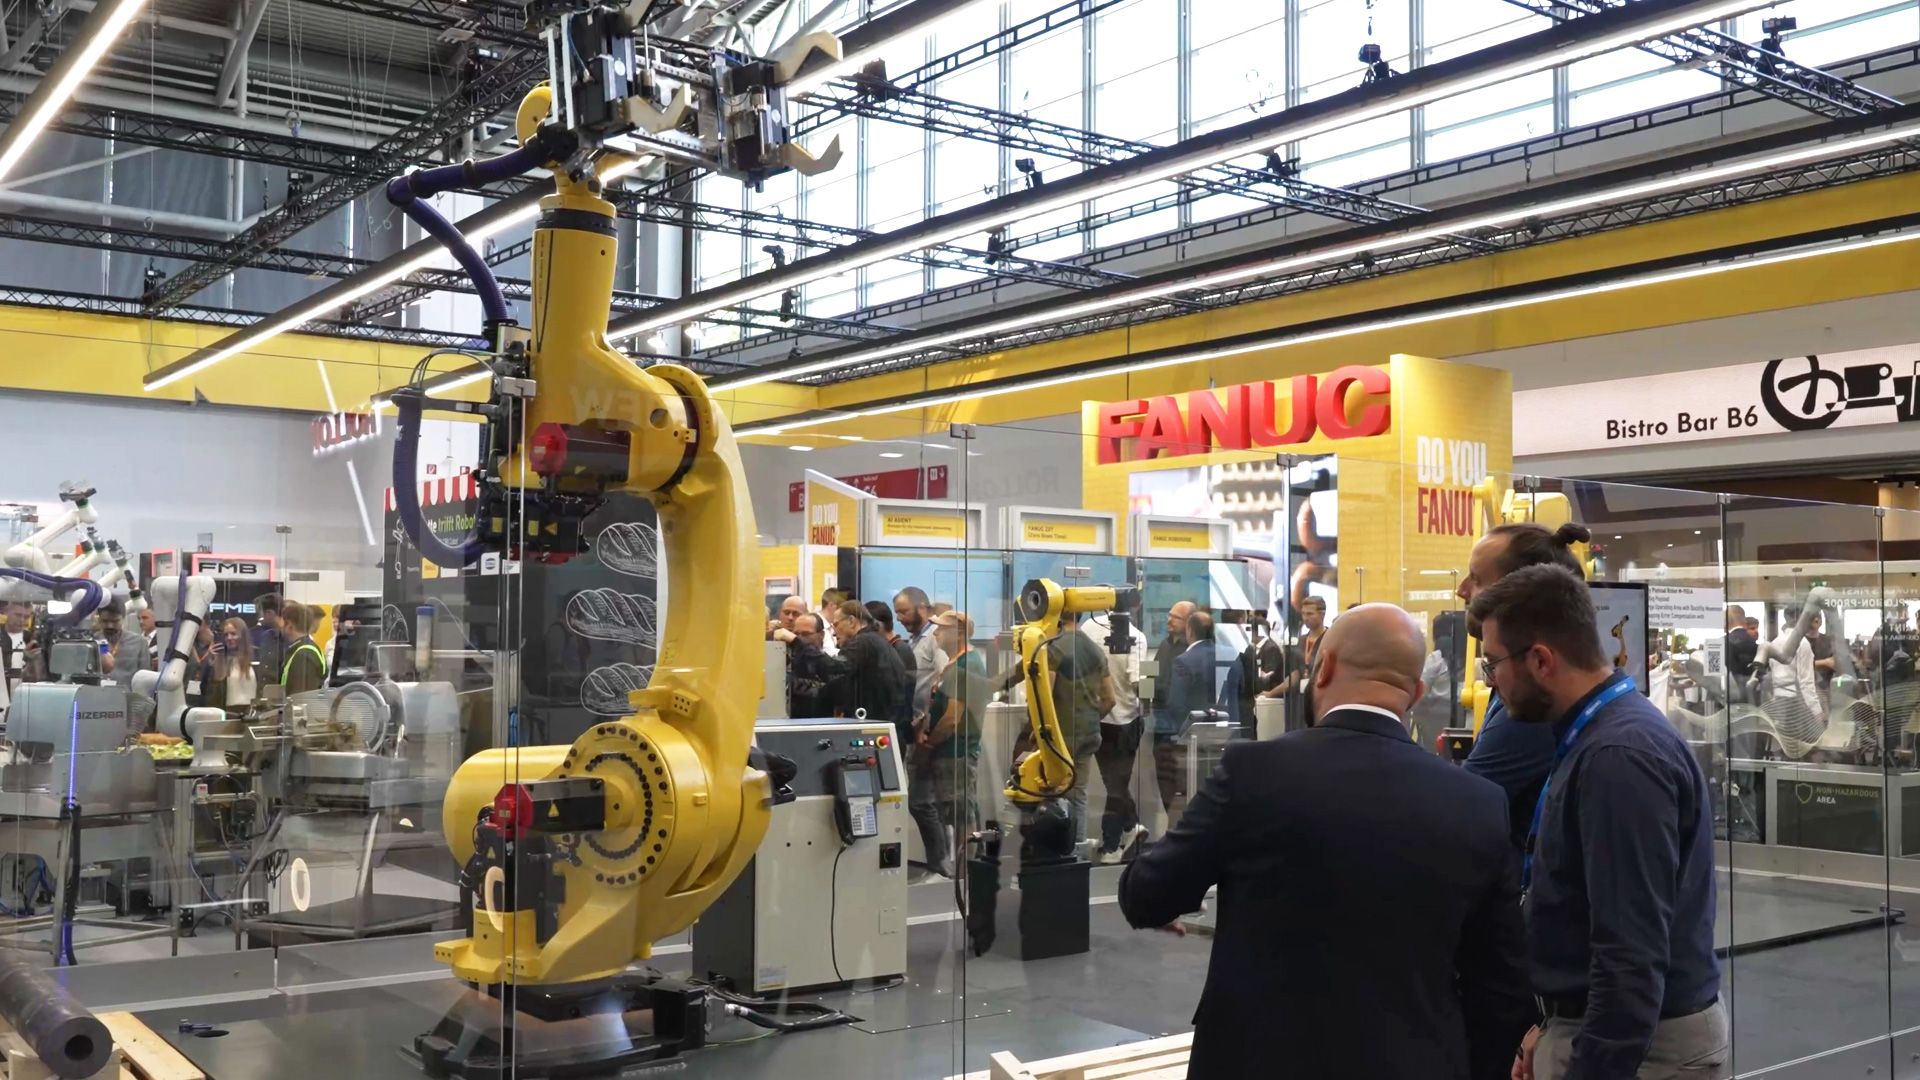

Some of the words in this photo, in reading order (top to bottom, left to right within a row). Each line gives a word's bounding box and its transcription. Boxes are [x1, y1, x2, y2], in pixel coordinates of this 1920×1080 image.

[1097, 365, 1392, 465] FANUC
[1606, 419, 1668, 439] Bistro
[1678, 412, 1718, 433] Bar
[1727, 405, 1758, 428] B6
[1417, 435, 1445, 485] DO
[1448, 439, 1487, 487] YOU
[812, 504, 823, 524] DO
[824, 503, 838, 524] YOU
[198, 562, 258, 574] FMB
[70, 711, 123, 720] BIZERBA
[1816, 787, 1880, 799] NON-HAZARDOUS
